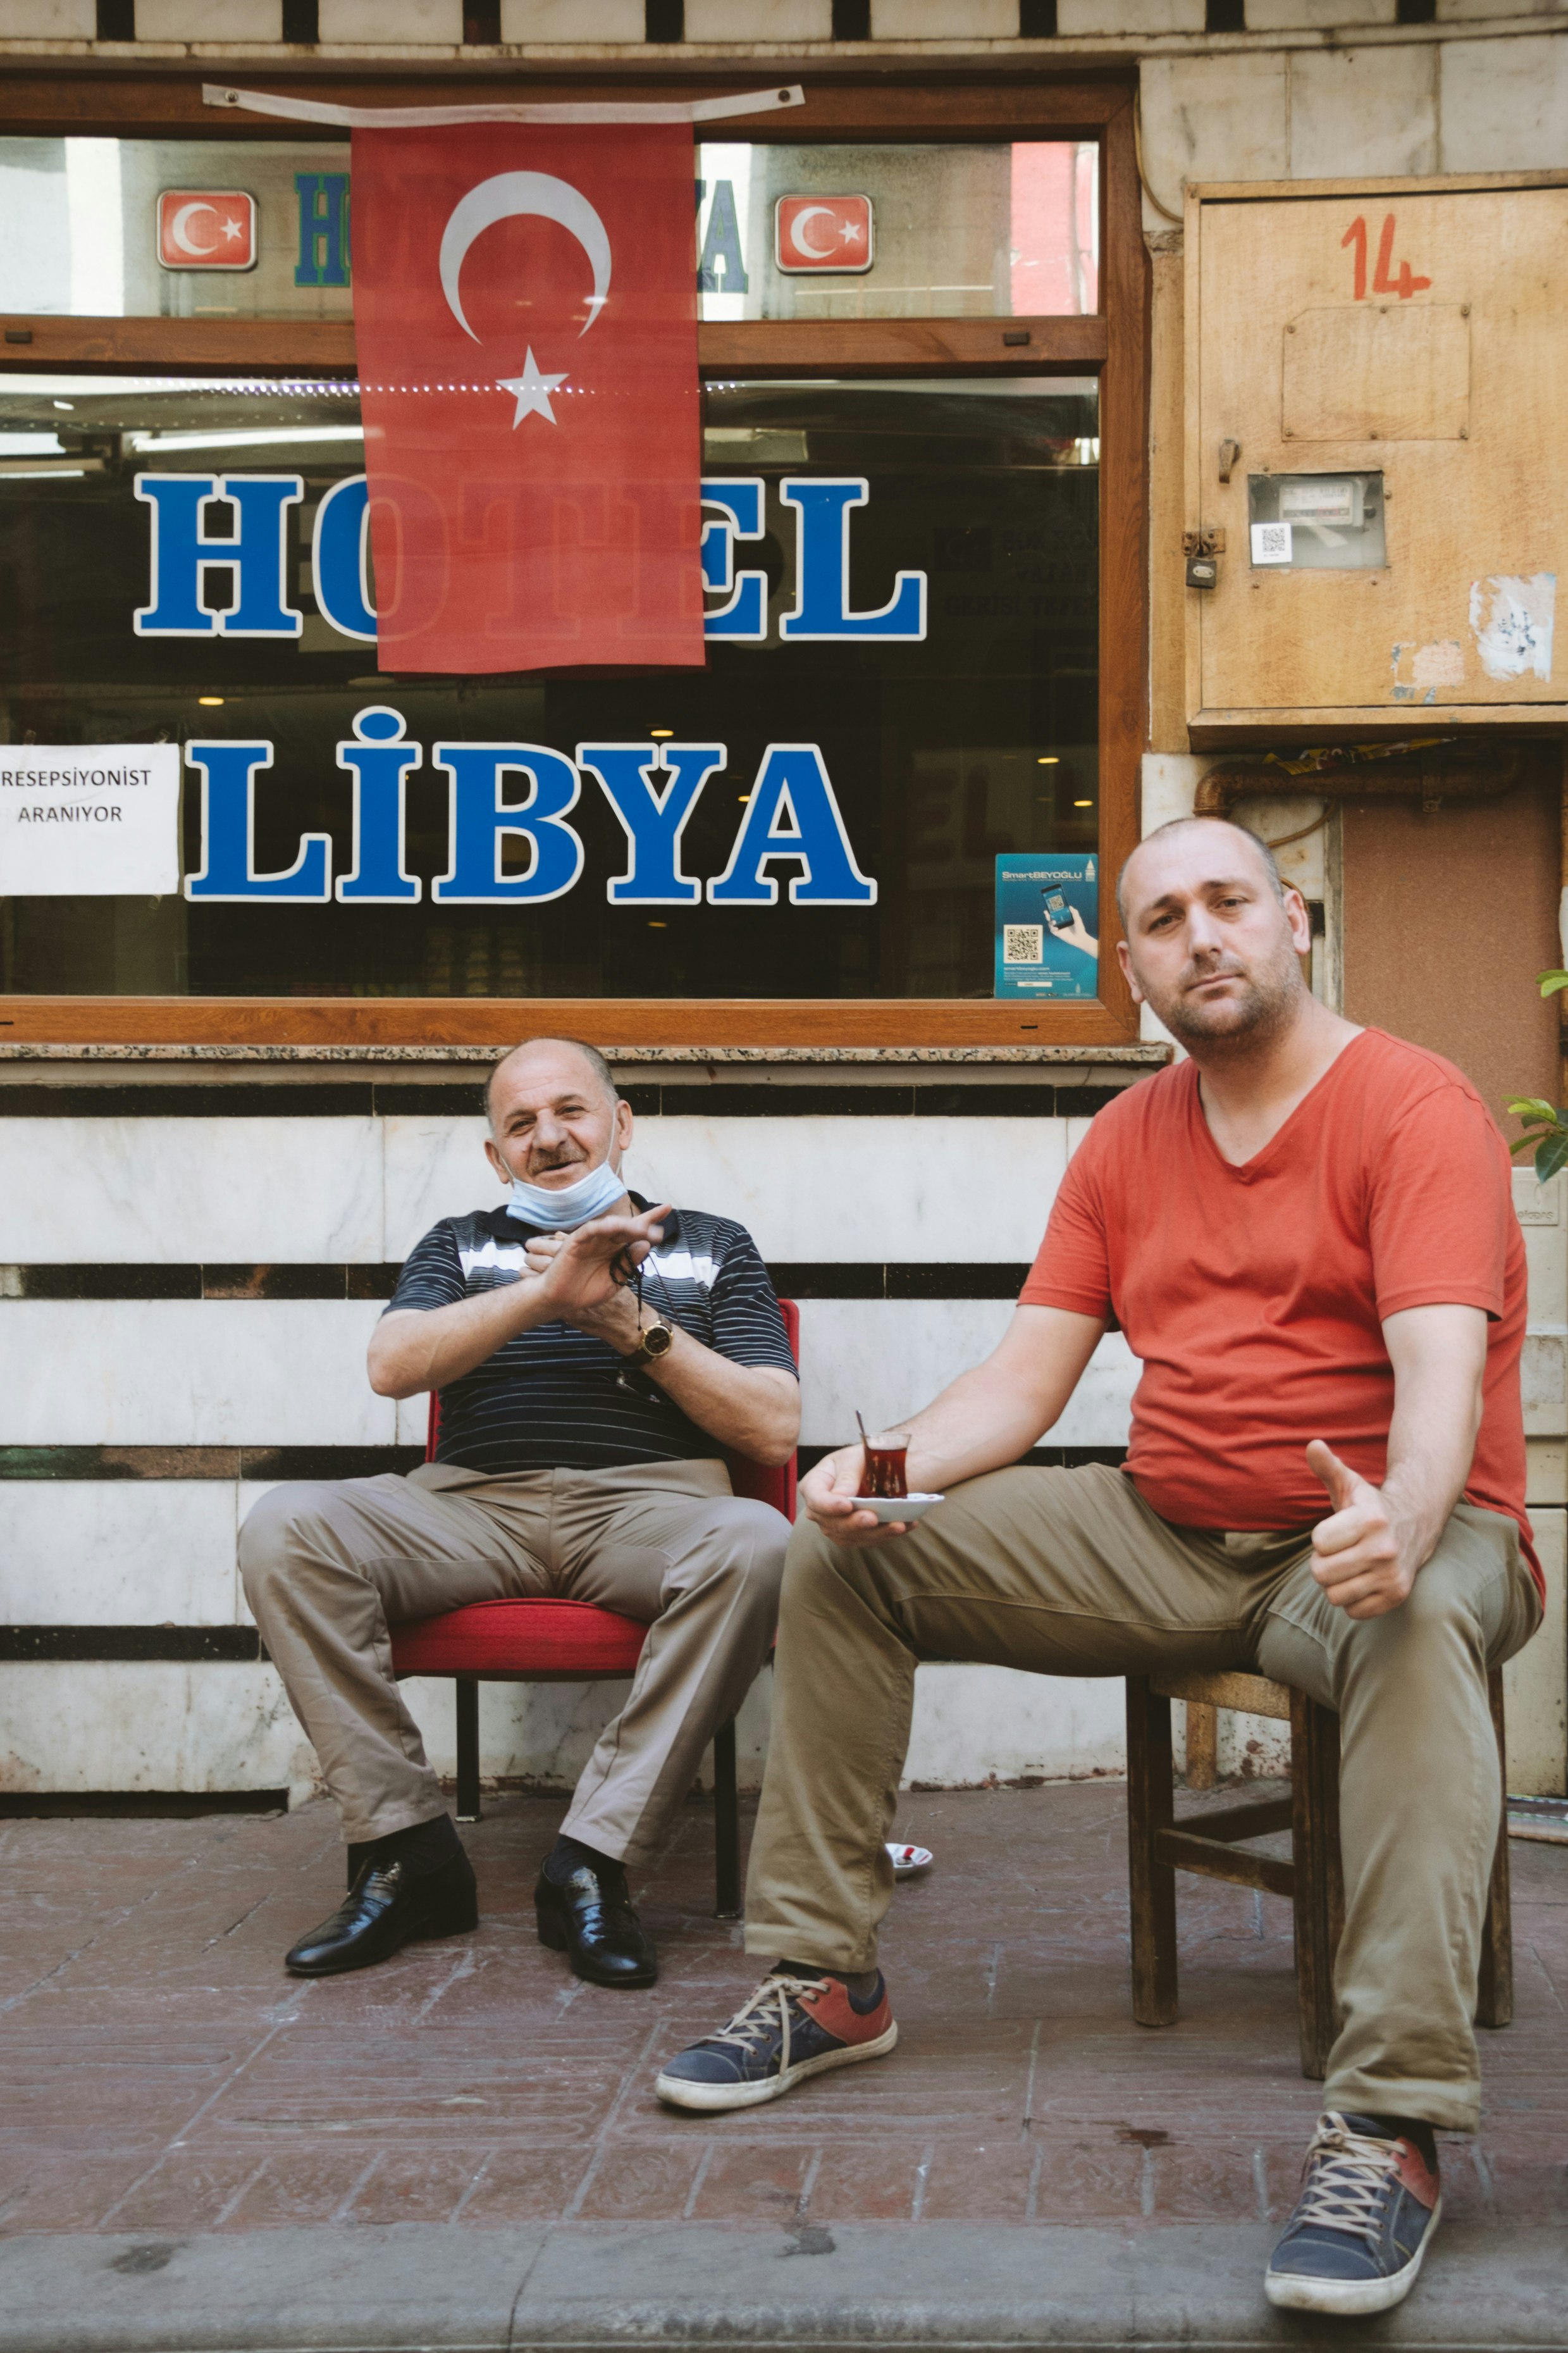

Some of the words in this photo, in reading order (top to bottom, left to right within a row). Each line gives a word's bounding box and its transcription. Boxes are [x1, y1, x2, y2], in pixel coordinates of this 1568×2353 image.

[1341, 213, 1431, 301] 14
[1, 766, 151, 786] RESEPSİYONİST
[18, 806, 123, 823] ARANIYOR
[184, 705, 878, 905] LİBYA
